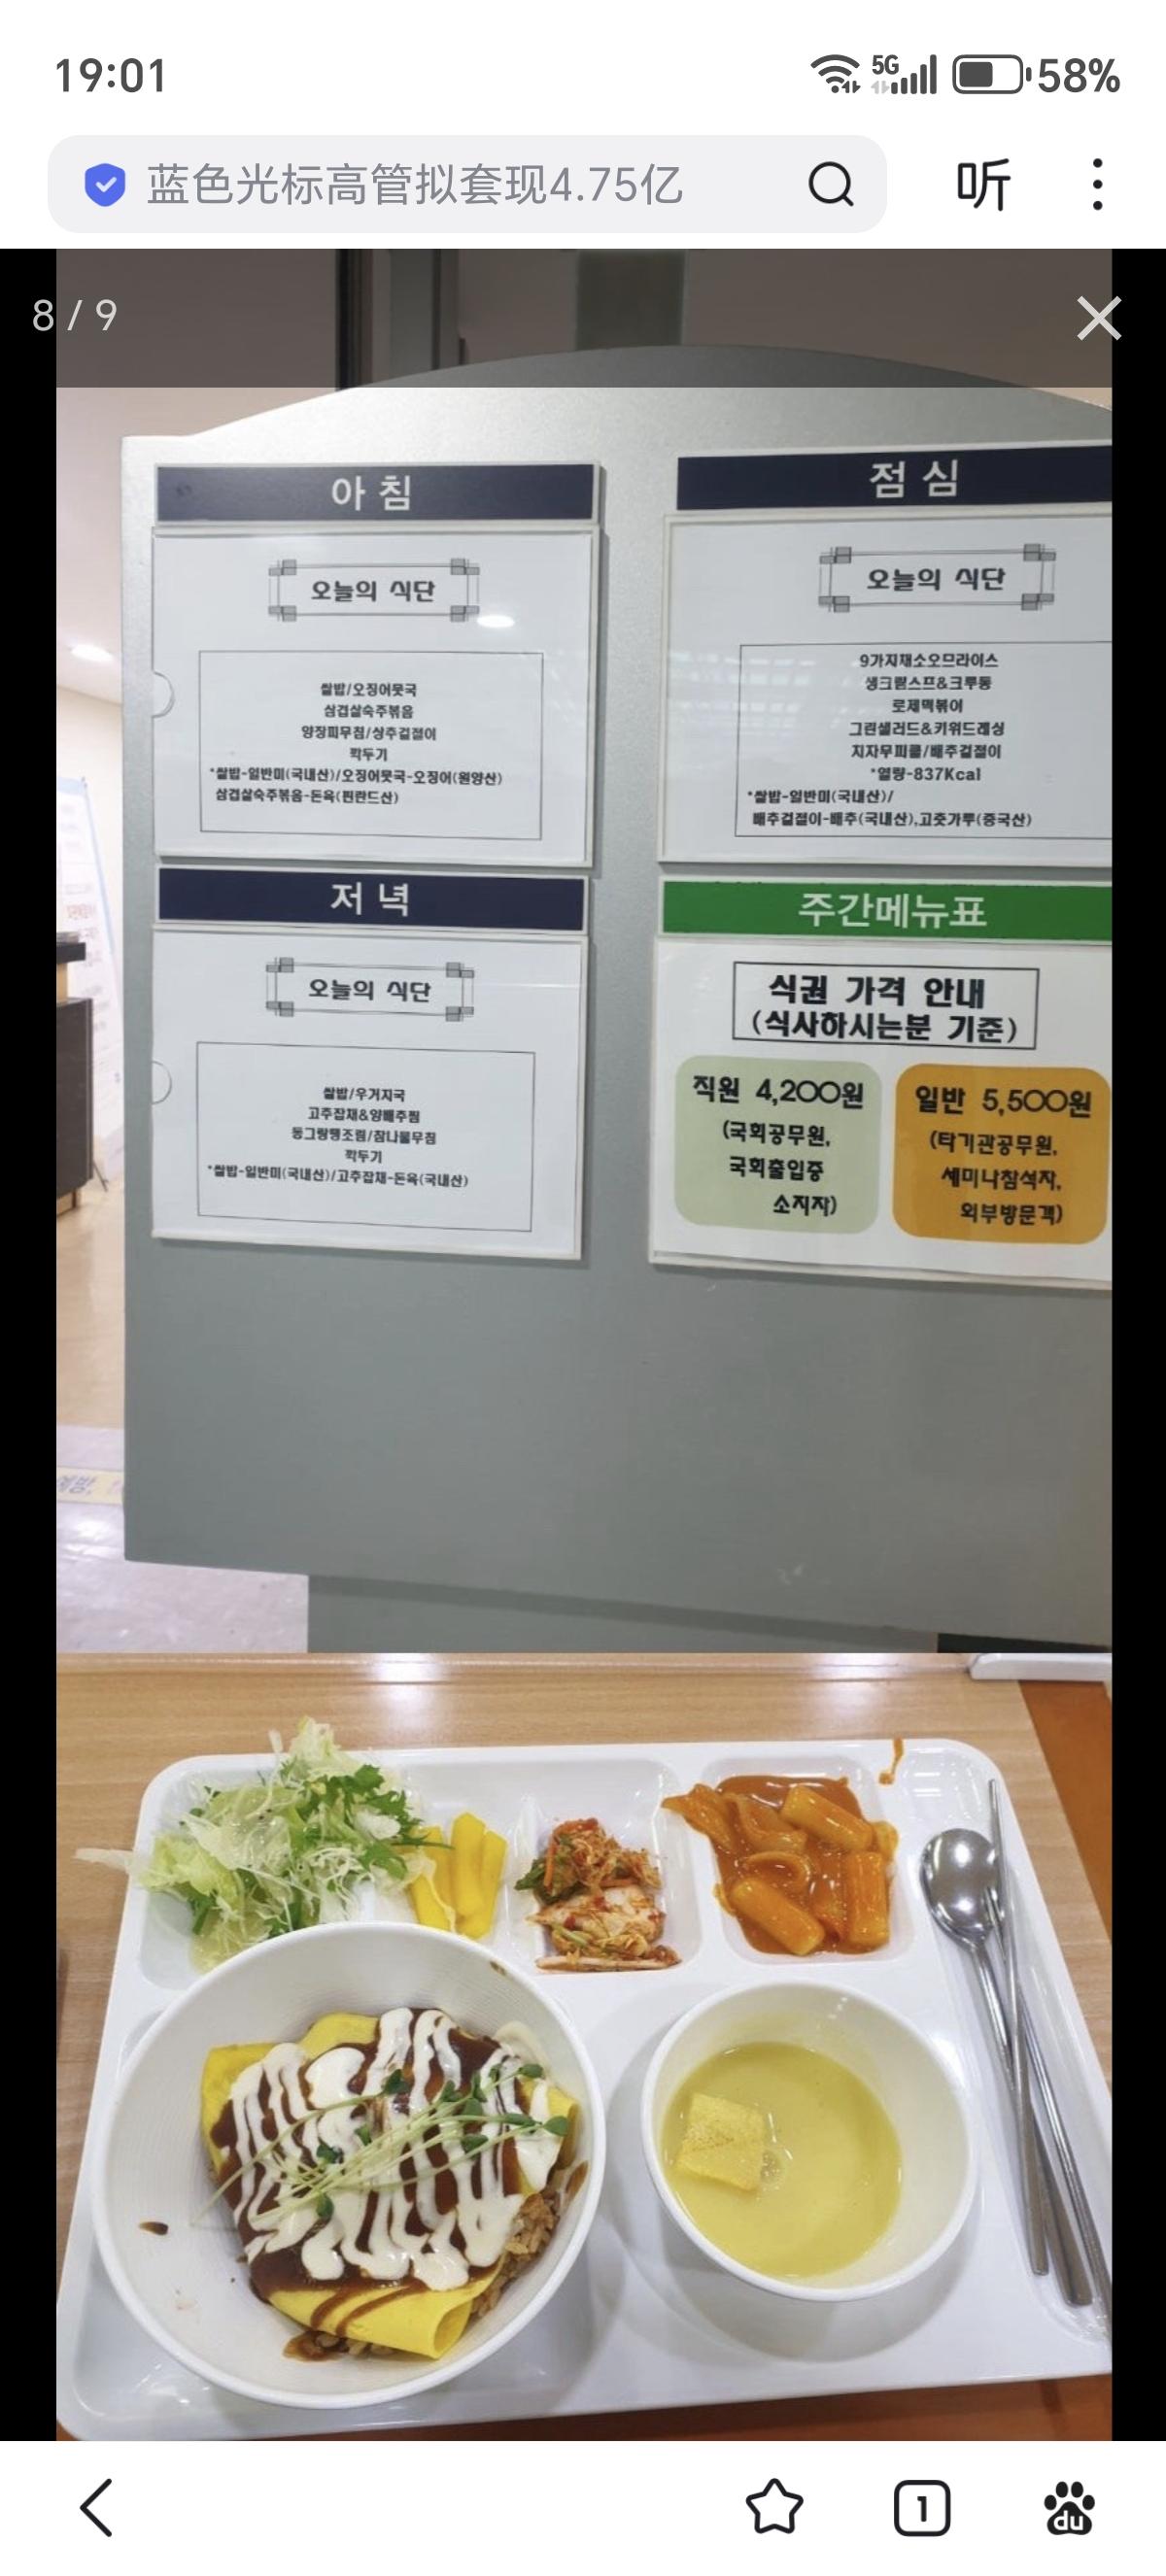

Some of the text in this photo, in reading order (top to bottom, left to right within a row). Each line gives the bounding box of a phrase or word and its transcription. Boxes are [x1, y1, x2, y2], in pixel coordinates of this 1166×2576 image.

[311, 581, 435, 602] 오늘의 식단
[867, 568, 1006, 592] 오늘의 식단
[860, 653, 998, 667] 9가지채소오므라이스
[325, 704, 413, 719] 삼겹살숙주볶음
[892, 698, 963, 713] 로제떡볶이
[799, 894, 987, 929] 주간메뉴표
[309, 979, 431, 1002] 오늘의 식단
[769, 974, 984, 1009] 식권 가격 안내
[752, 1009, 1016, 1043] (식사하시는분 기준)
[324, 1087, 405, 1102] 쌀밥/우거지국
[693, 1075, 863, 1109] 직원 4,200원
[915, 1086, 1091, 1118] 일반 5,500원
[723, 1120, 830, 1147] (국회공무원,
[930, 1131, 1057, 1156] (타기관공무원,
[730, 1156, 824, 1182] 국회출입증
[942, 1167, 1061, 1191] 세미나참석자,
[773, 1195, 837, 1217] 소지자)
[961, 1203, 1063, 1226] 외부방문객)
